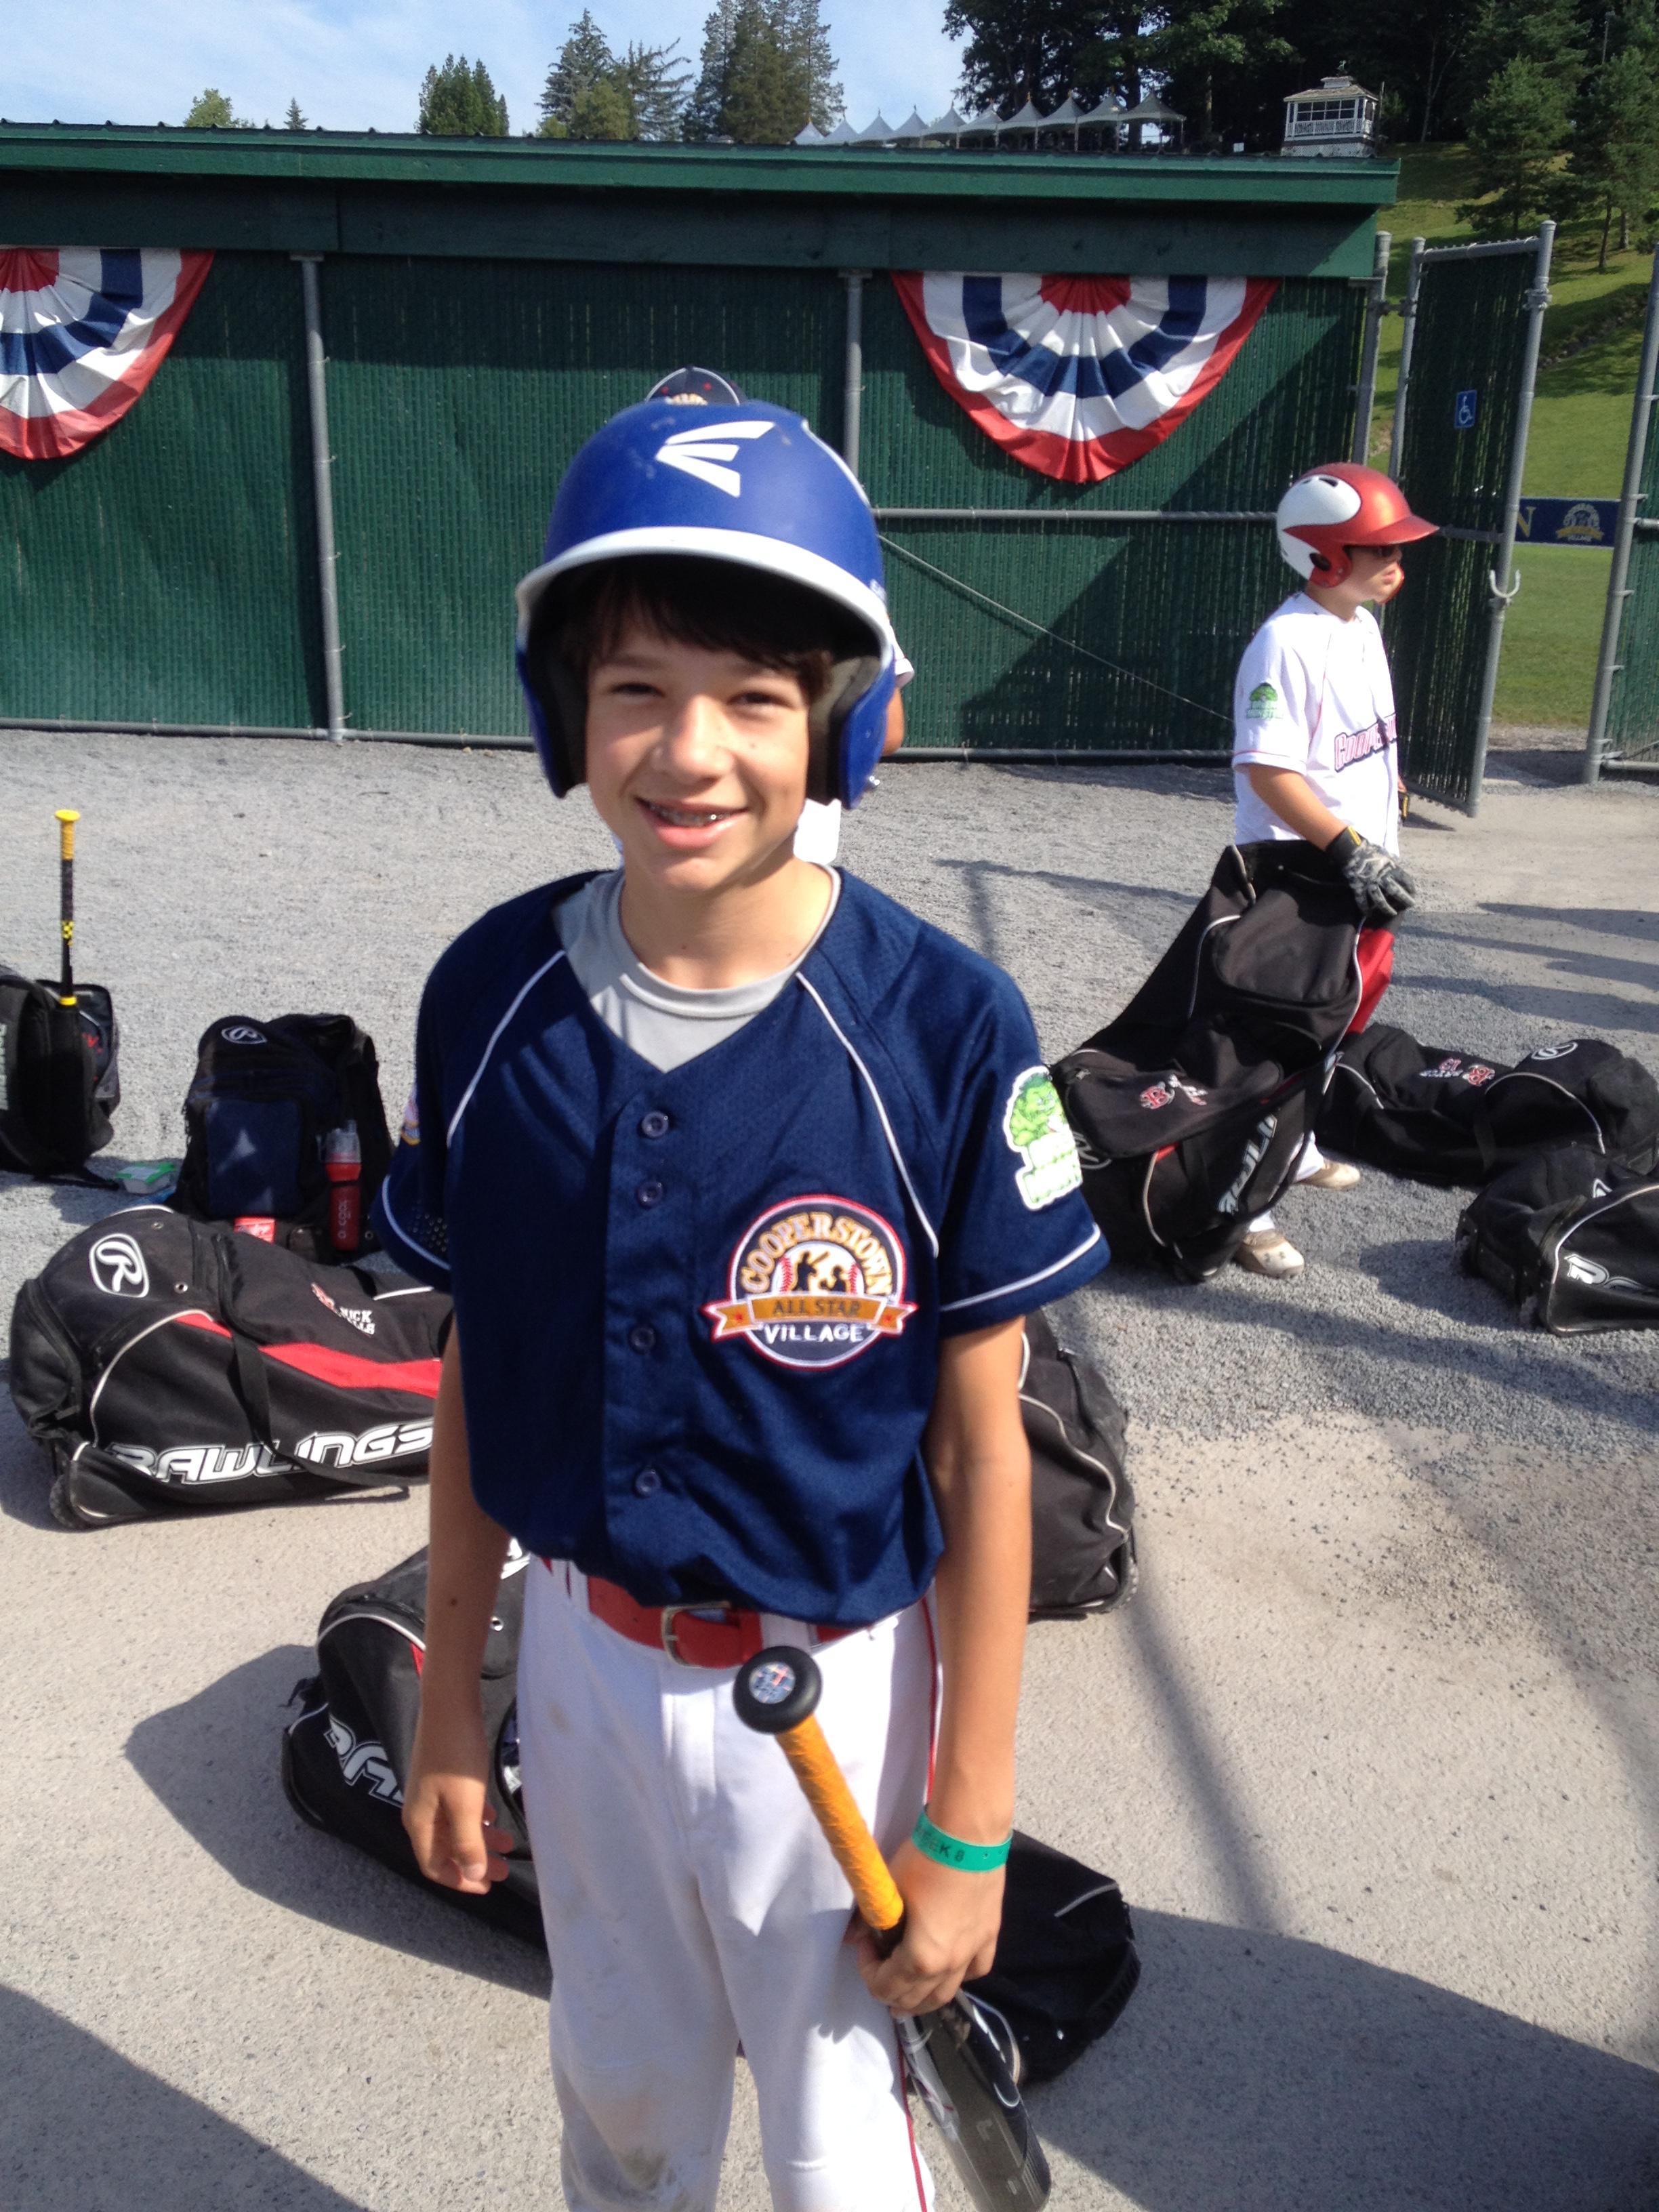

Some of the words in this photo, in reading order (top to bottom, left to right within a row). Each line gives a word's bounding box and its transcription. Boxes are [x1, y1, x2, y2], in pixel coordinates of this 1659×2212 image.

[740, 1211, 893, 1294] COOPERSTOWN
[772, 1300, 806, 1316] ALL
[813, 1300, 861, 1315] STAR
[762, 1324, 865, 1344] VILLAGE
